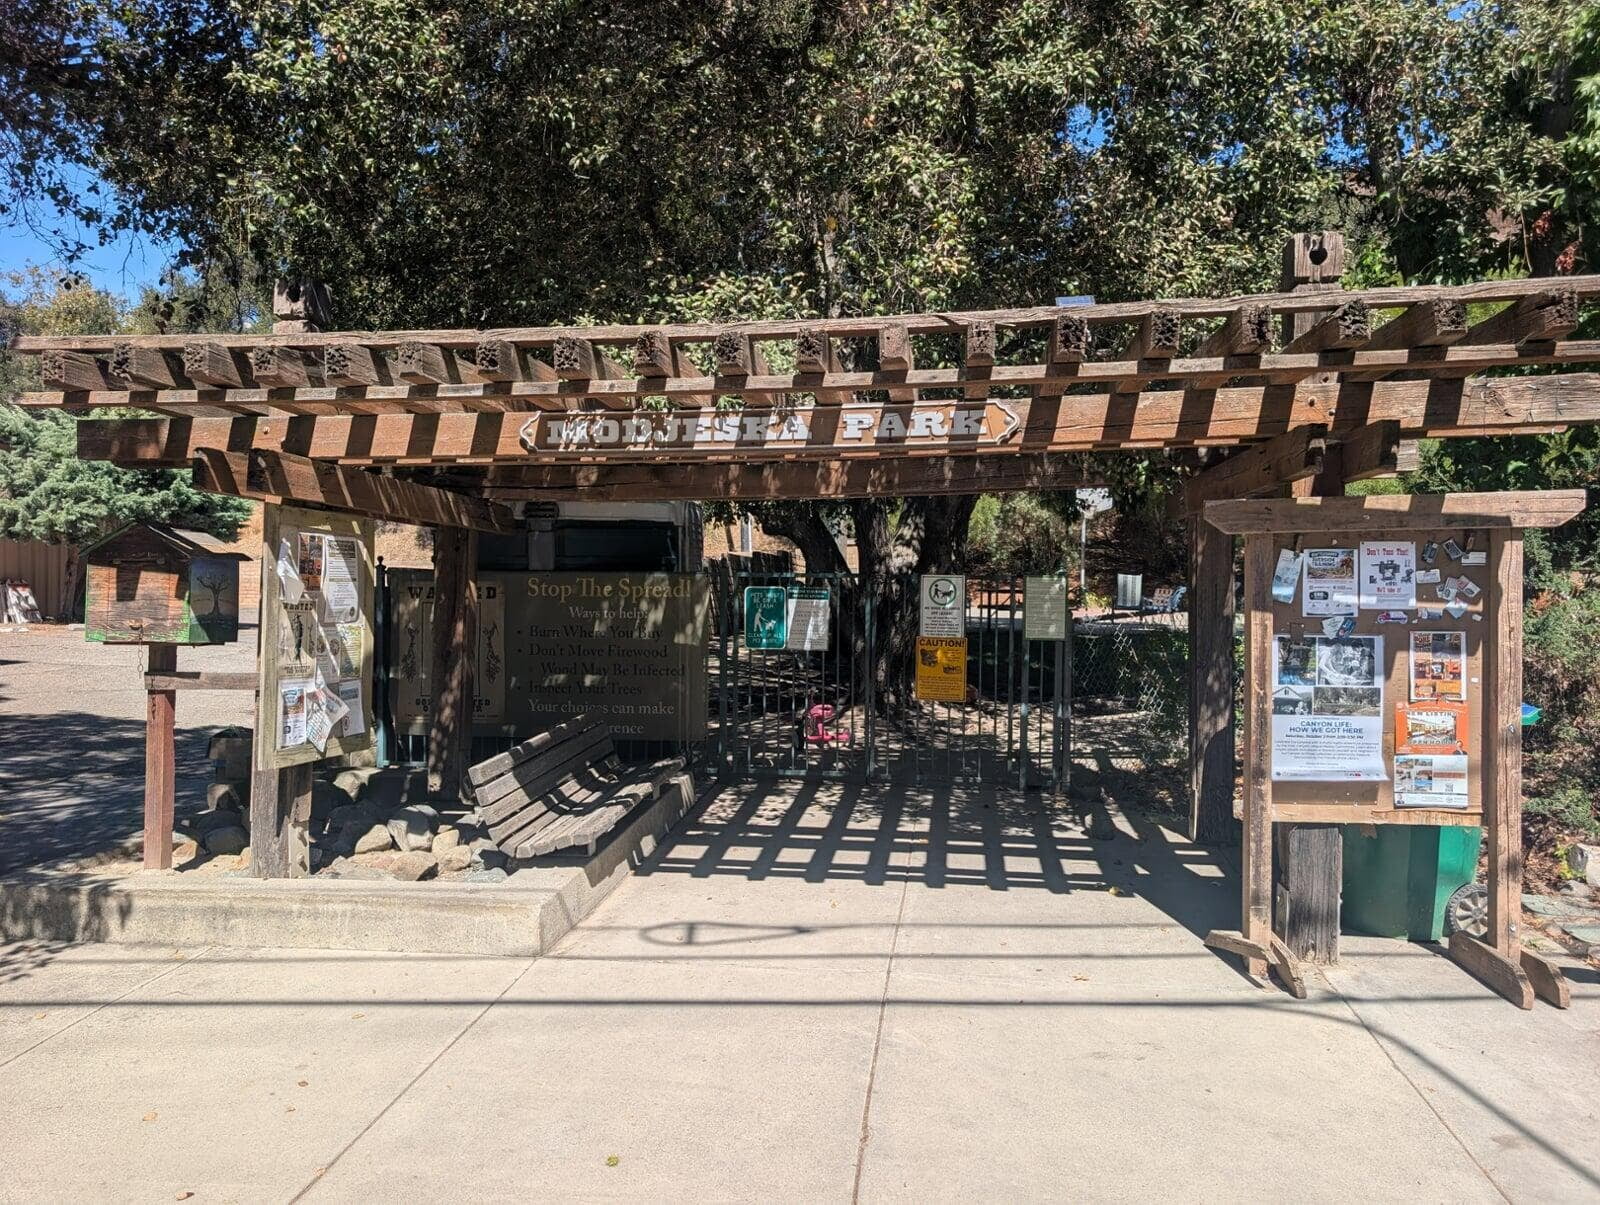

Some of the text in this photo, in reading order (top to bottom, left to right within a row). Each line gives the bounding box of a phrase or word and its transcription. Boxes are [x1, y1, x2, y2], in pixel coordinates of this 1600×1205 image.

[546, 409, 988, 444] MODJESKA PARK
[527, 577, 691, 602] Stop The Spread!
[569, 606, 601, 619] Ways
[604, 607, 616, 618] to
[530, 626, 560, 638] Burn
[564, 626, 606, 638] Where
[610, 626, 634, 638] You
[529, 643, 668, 658] Don't Move Firewood
[919, 639, 965, 647] CAUTION!
[541, 662, 686, 677] Wood May Be Infected
[610, 682, 642, 695] Trees
[528, 699, 559, 713] Your
[611, 703, 635, 714] can
[638, 701, 675, 714] make
